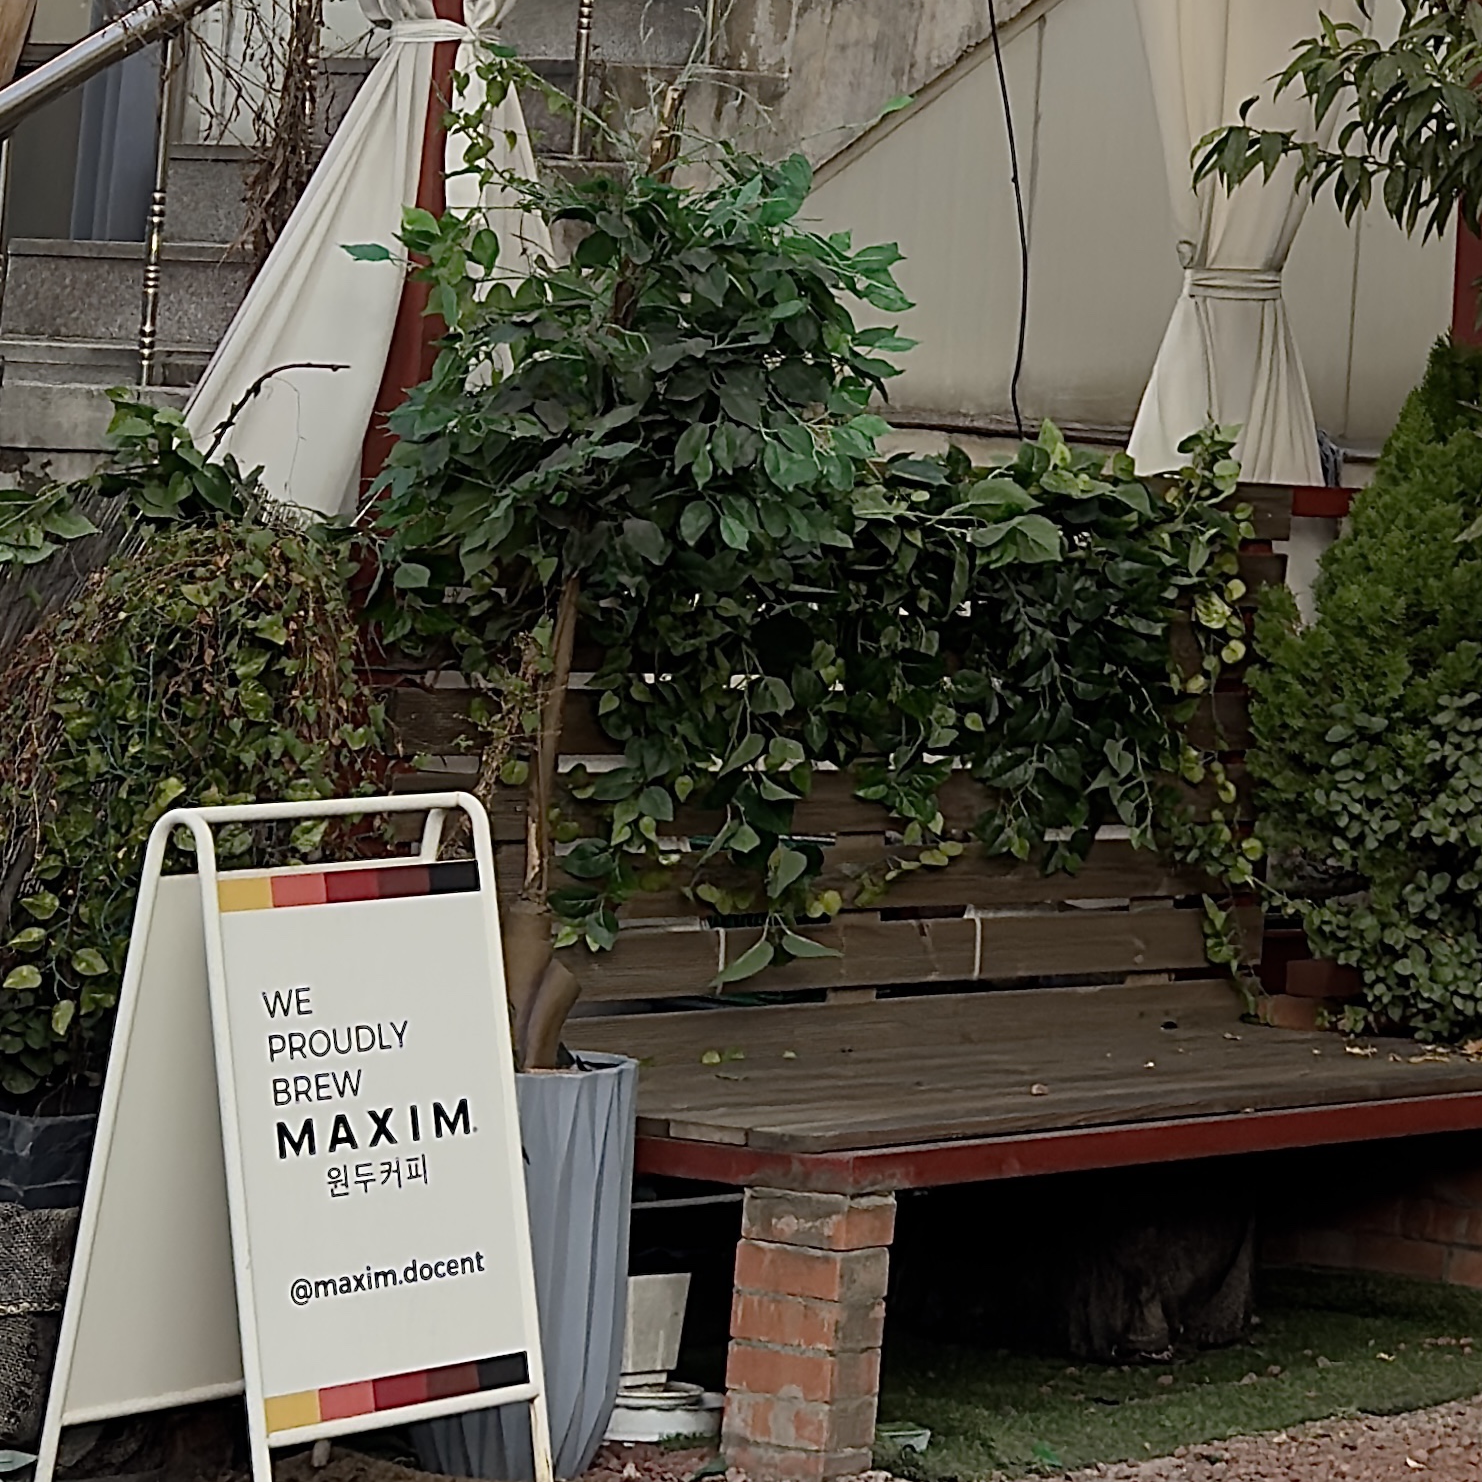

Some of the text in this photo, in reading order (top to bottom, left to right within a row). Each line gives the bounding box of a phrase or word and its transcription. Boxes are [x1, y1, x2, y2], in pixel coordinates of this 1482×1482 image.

[262, 987, 313, 1019] WE
[268, 1020, 408, 1062] PROUDLY
[272, 1069, 362, 1106] BREW
[276, 1098, 472, 1160] MAXIM
[326, 1153, 429, 1198] 원두커피
[290, 1251, 486, 1306] @maxim.docent
